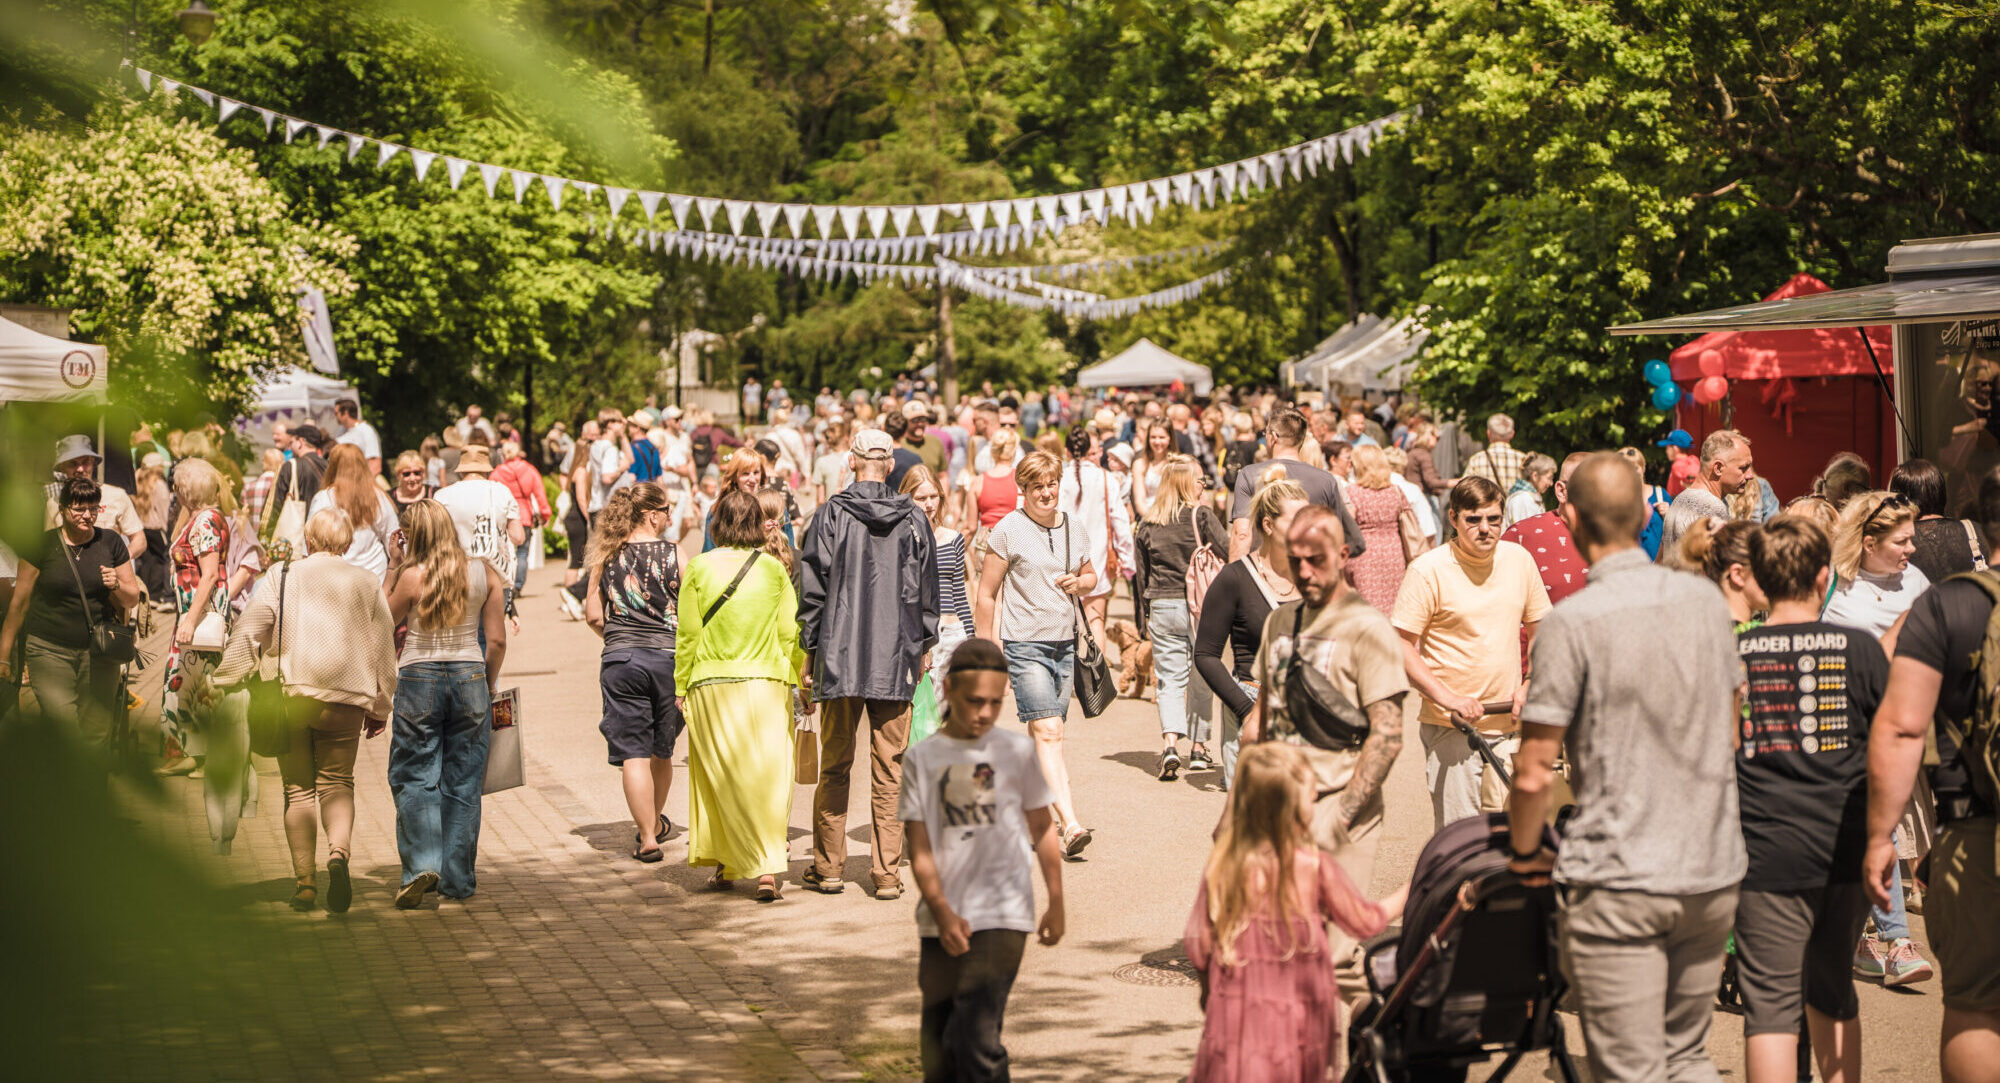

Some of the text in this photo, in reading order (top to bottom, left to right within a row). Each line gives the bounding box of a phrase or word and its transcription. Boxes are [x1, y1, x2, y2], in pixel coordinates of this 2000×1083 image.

[67, 361, 90, 377] TM
[1739, 632, 1848, 655] EADER BOARD
